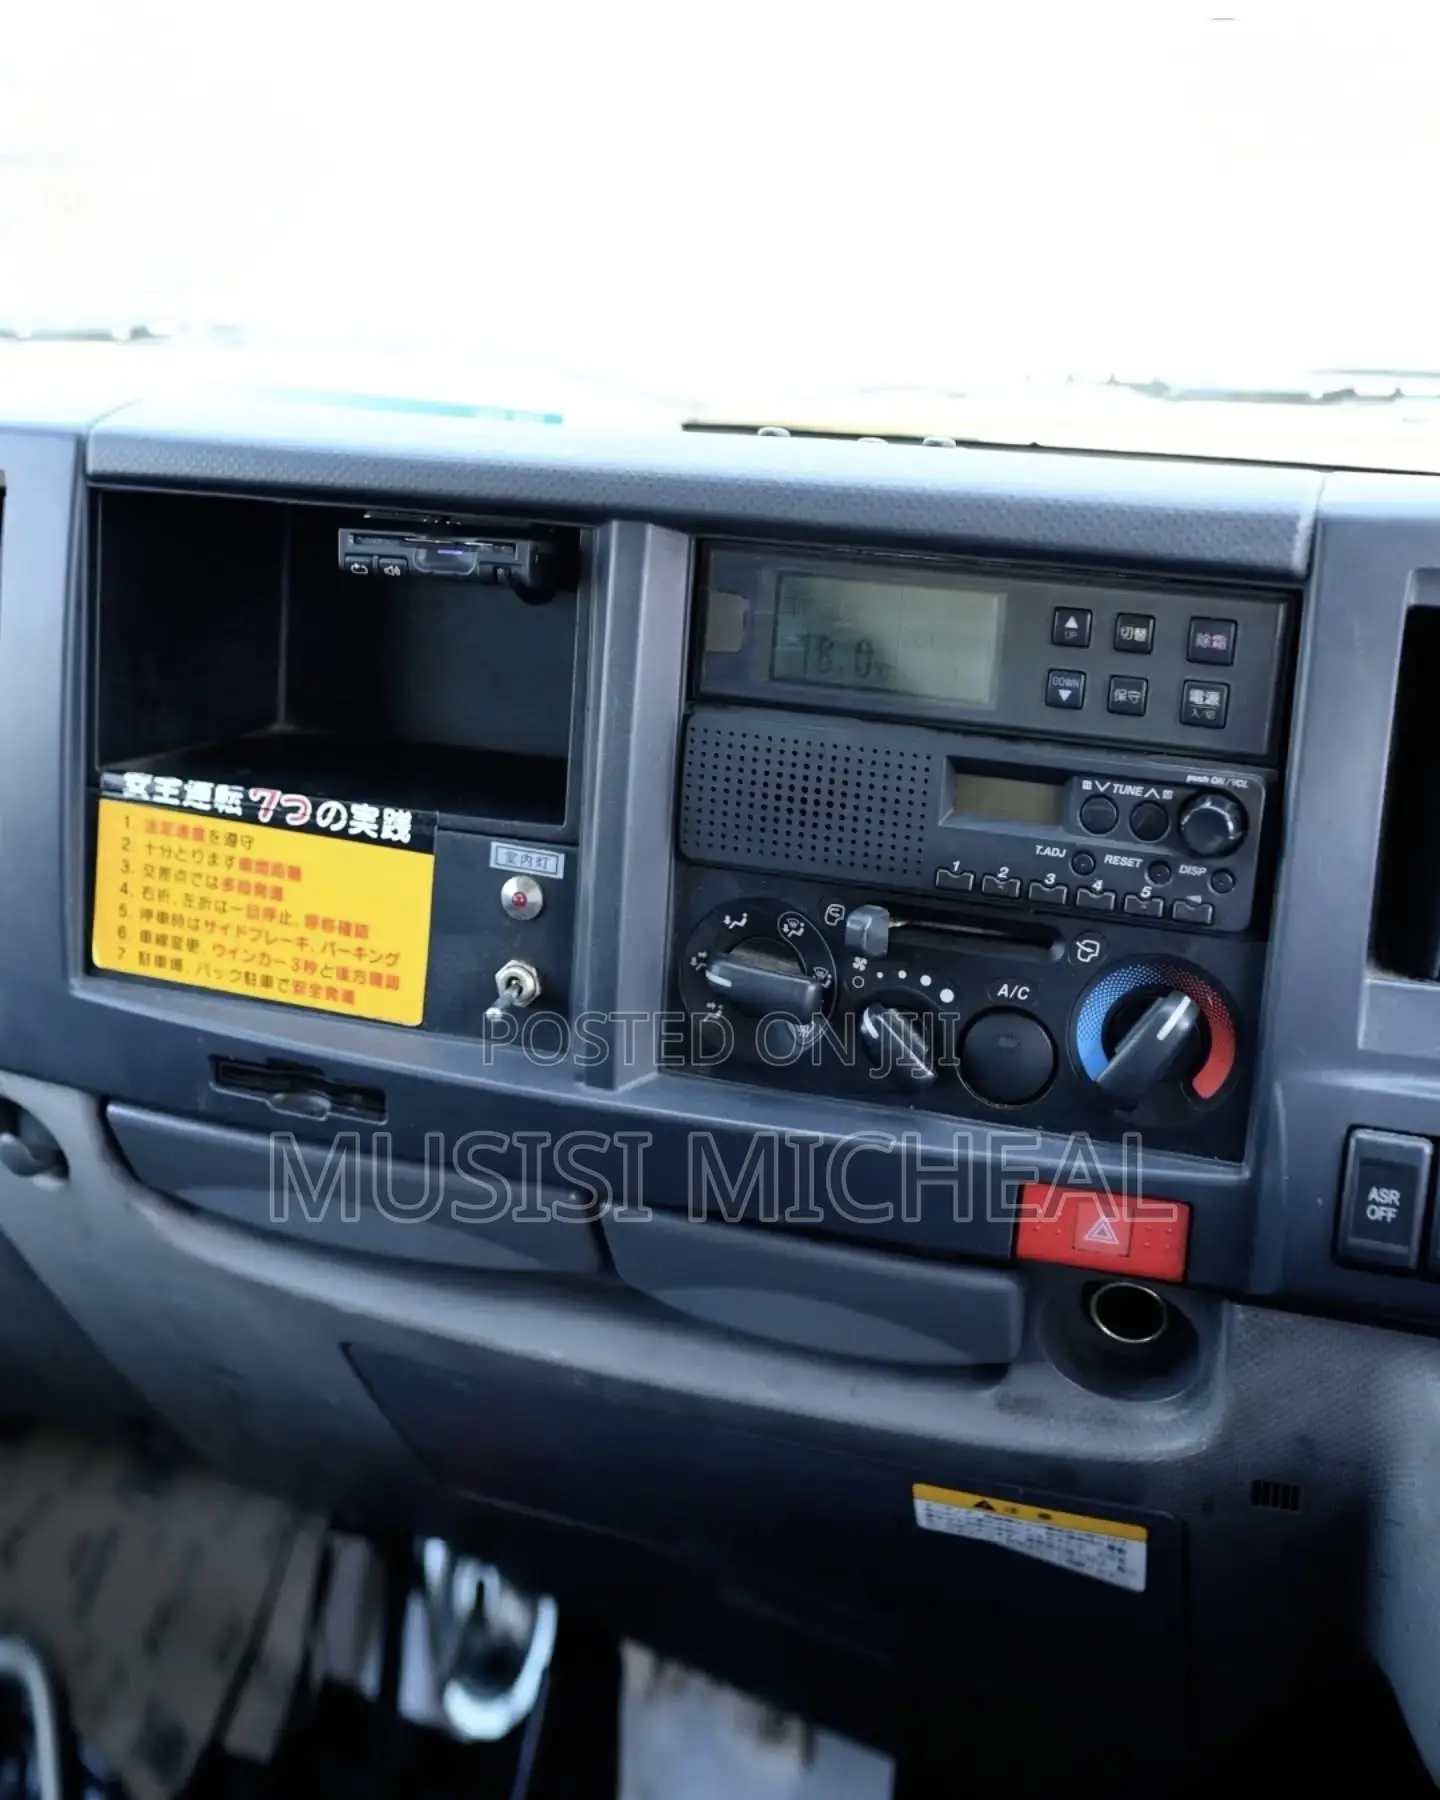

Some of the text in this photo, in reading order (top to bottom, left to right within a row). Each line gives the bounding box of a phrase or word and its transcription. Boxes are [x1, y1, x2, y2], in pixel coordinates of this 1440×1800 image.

[1052, 676, 1079, 688] DOWN
[1112, 783, 1146, 797] TUNE
[1035, 844, 1067, 858] T.ADJ
[952, 860, 961, 872] 1
[1104, 854, 1143, 868] RESET
[998, 866, 1010, 879] 2
[1178, 864, 1207, 876] DISP
[1044, 873, 1056, 885] 3
[1092, 879, 1103, 891] 4
[1140, 886, 1152, 898] 5
[997, 983, 1030, 1000] A/C
[1368, 1186, 1400, 1206] ASR
[1366, 1204, 1398, 1224] OFF
